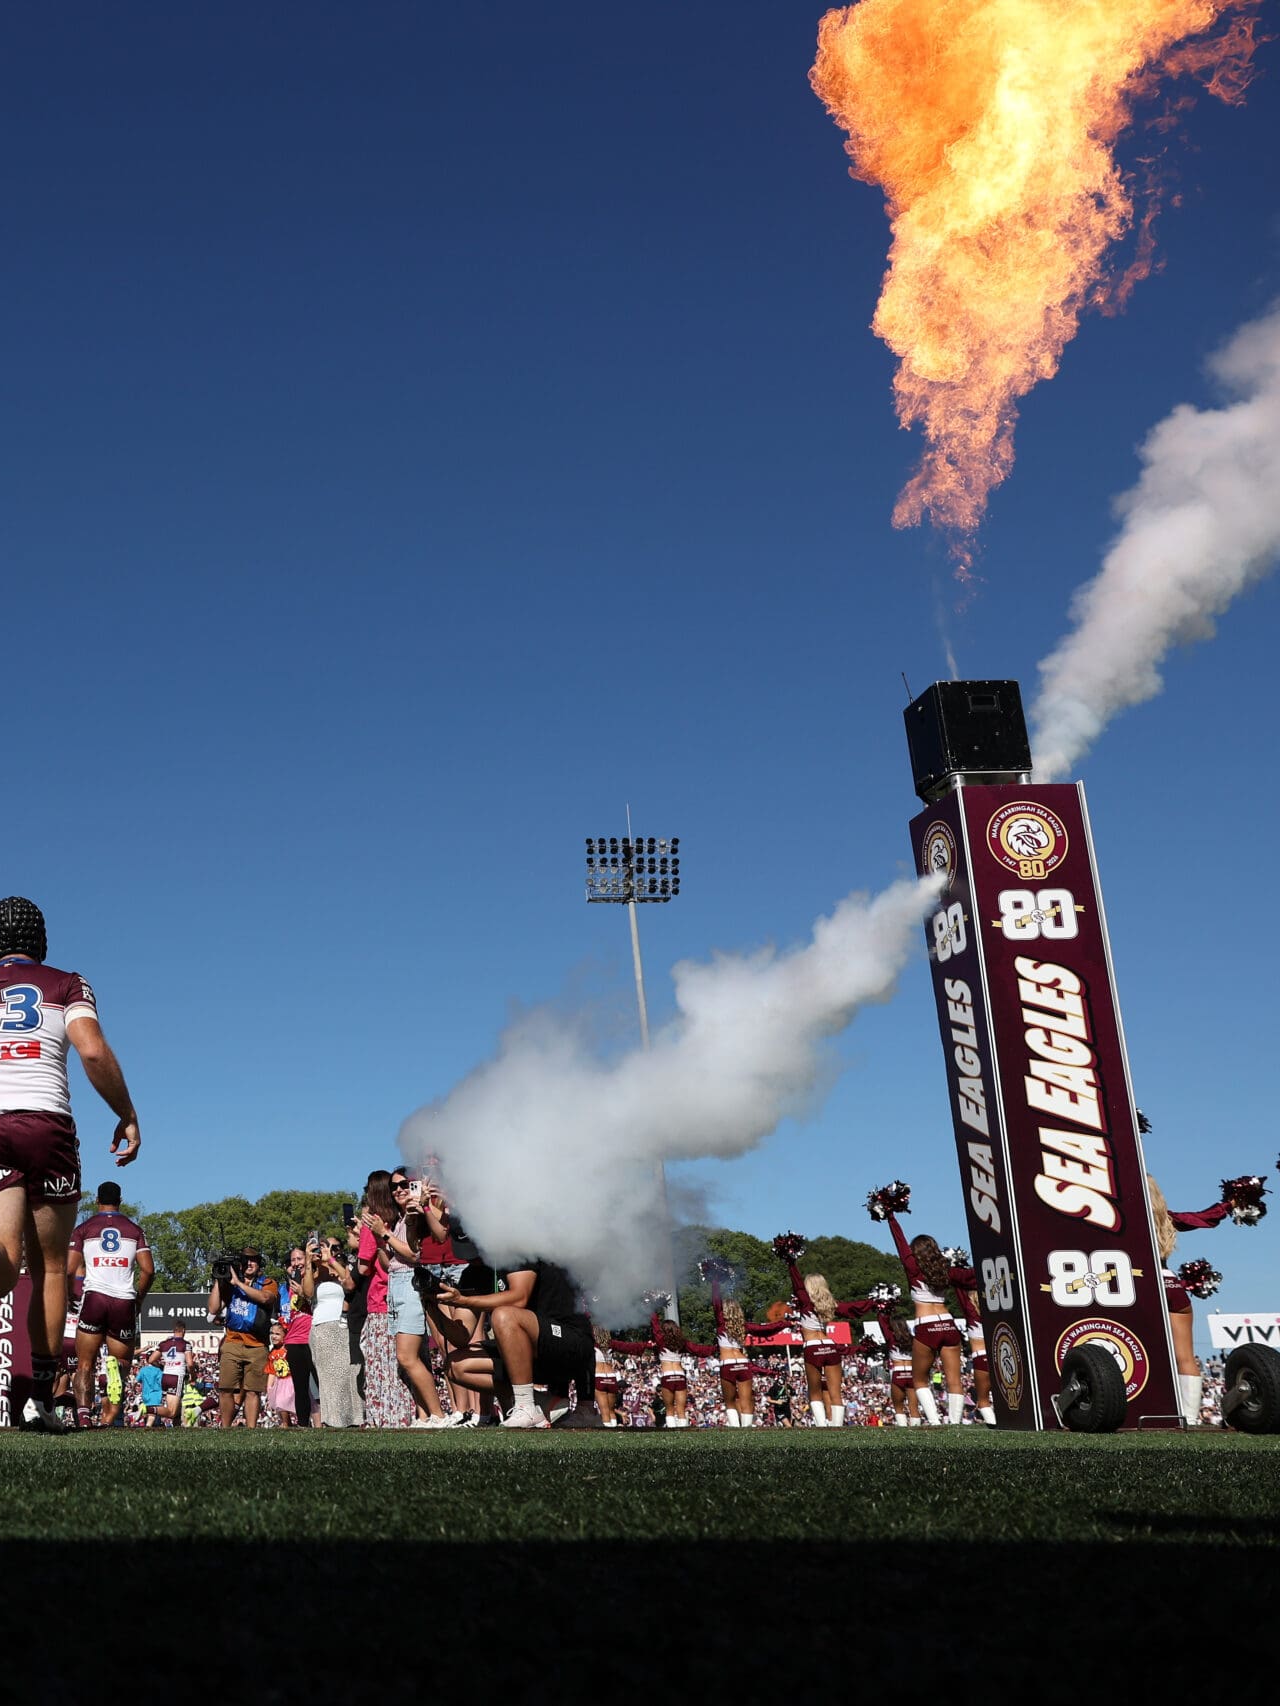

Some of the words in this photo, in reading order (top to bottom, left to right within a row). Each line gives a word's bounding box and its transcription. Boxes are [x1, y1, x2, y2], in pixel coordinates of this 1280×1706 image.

[991, 818, 1003, 839] MANLY
[999, 804, 1037, 820] WARRINGAH
[1036, 808, 1048, 819] SEA
[1047, 815, 1063, 838] EAGLES
[1019, 859, 1046, 877] 80
[933, 902, 968, 961] 80
[998, 888, 1079, 940] 80
[944, 977, 991, 1138] EAGLES
[1014, 955, 1103, 1131] EAGLES
[967, 1141, 1001, 1234] SEA
[1033, 1126, 1117, 1230] SEA
[97, 1258, 125, 1267] KFC
[100, 1227, 121, 1254] 8
[981, 1255, 1014, 1312] 80
[1047, 1249, 1137, 1307] 80
[167, 1307, 175, 1317] 4
[176, 1307, 207, 1317] PINES
[167, 1346, 177, 1359] 4
[1070, 1323, 1112, 1339] WARRINGAH
[1112, 1327, 1126, 1339] SEA
[1125, 1336, 1143, 1361] EAGLES
